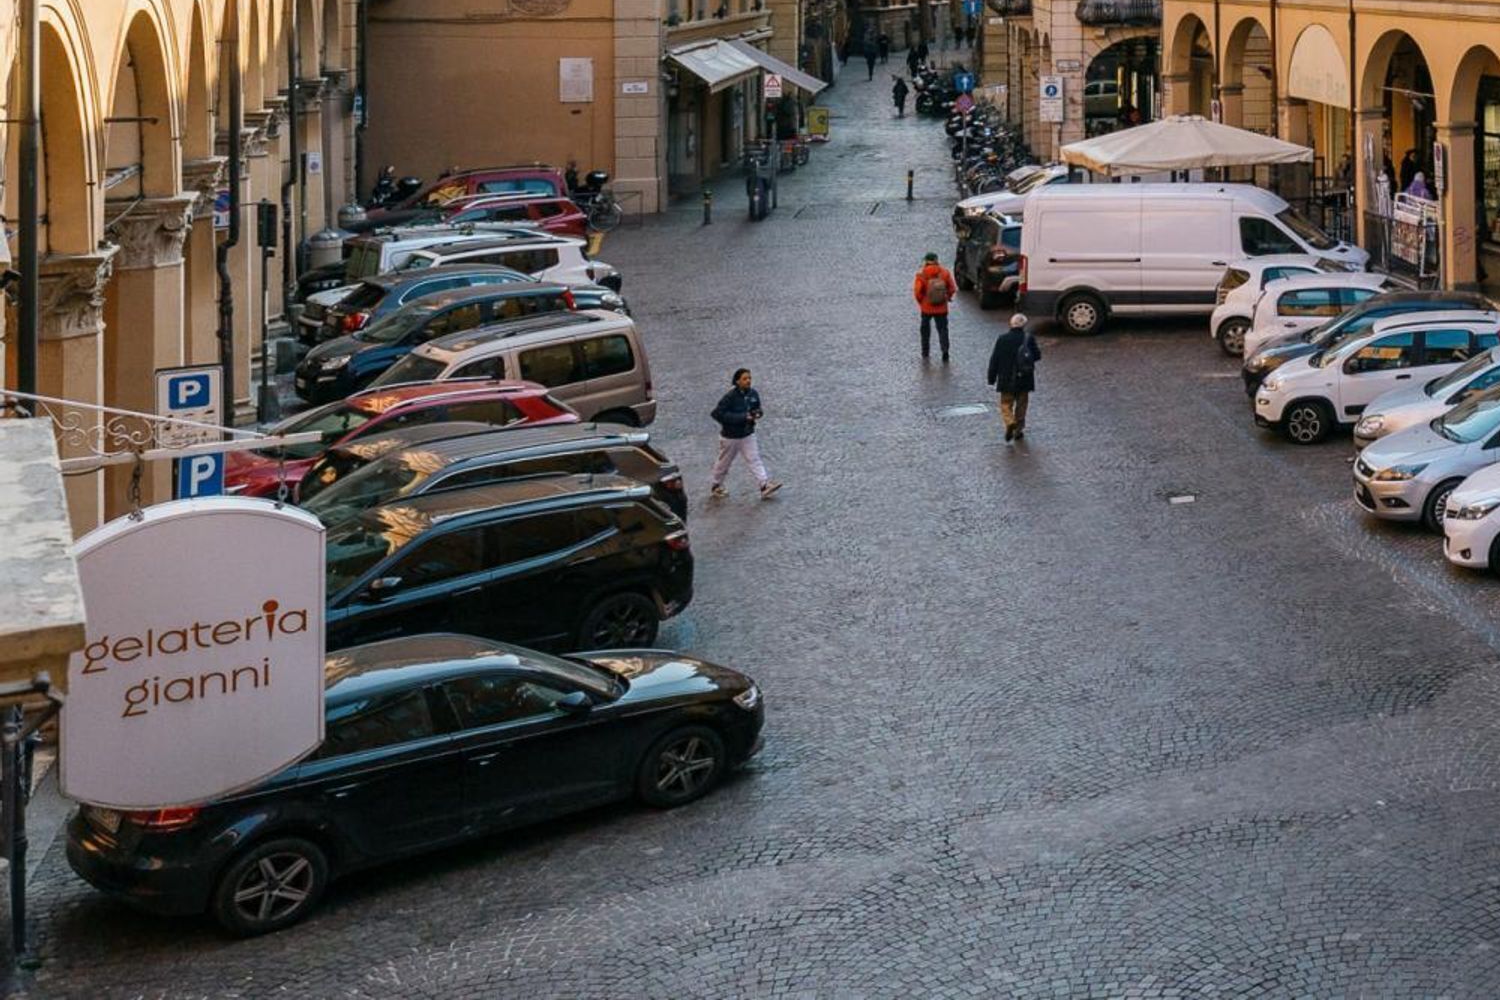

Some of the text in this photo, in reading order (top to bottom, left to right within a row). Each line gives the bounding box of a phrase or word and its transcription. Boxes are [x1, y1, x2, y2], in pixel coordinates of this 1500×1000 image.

[178, 380, 202, 404] P
[190, 455, 216, 498] P
[82, 600, 307, 674] gelateria
[121, 657, 270, 718] gianni
